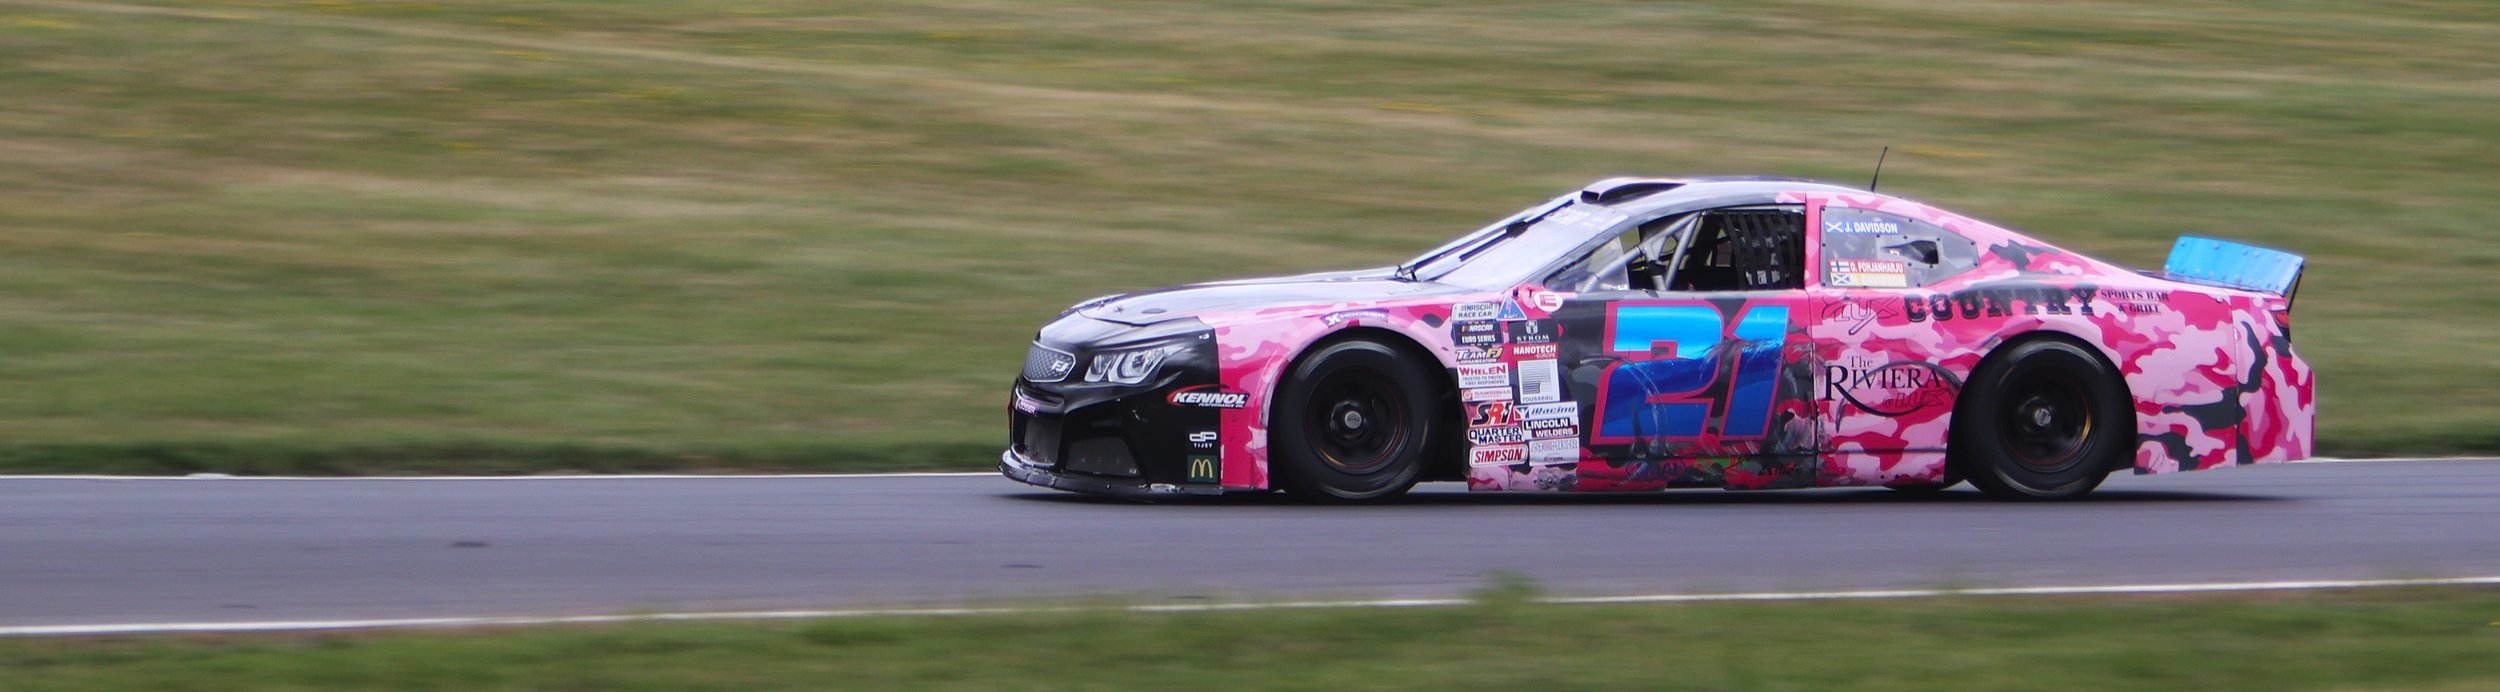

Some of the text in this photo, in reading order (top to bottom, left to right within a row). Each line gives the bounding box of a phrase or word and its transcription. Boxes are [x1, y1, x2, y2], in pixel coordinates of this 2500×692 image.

[1844, 222, 1898, 234] J. DAVIDSON
[2101, 290, 2170, 300] SPORTS BAR
[1904, 284, 2099, 323] COUNTRY
[2129, 304, 2161, 314] GRILL
[1469, 324, 1494, 332] NASCAR
[1513, 345, 1557, 355] NANOTECH
[1848, 356, 1874, 368] The
[1591, 300, 1789, 444] 21
[1172, 393, 1246, 404] KENNOL
[1531, 405, 1576, 416] iRacing
[1525, 418, 1568, 430] LINCOLN
[1469, 427, 1519, 440] QUARTER
[1535, 429, 1574, 438] WELDERS
[1479, 434, 1523, 445] MASTER
[1474, 449, 1523, 464] SIMPSON
